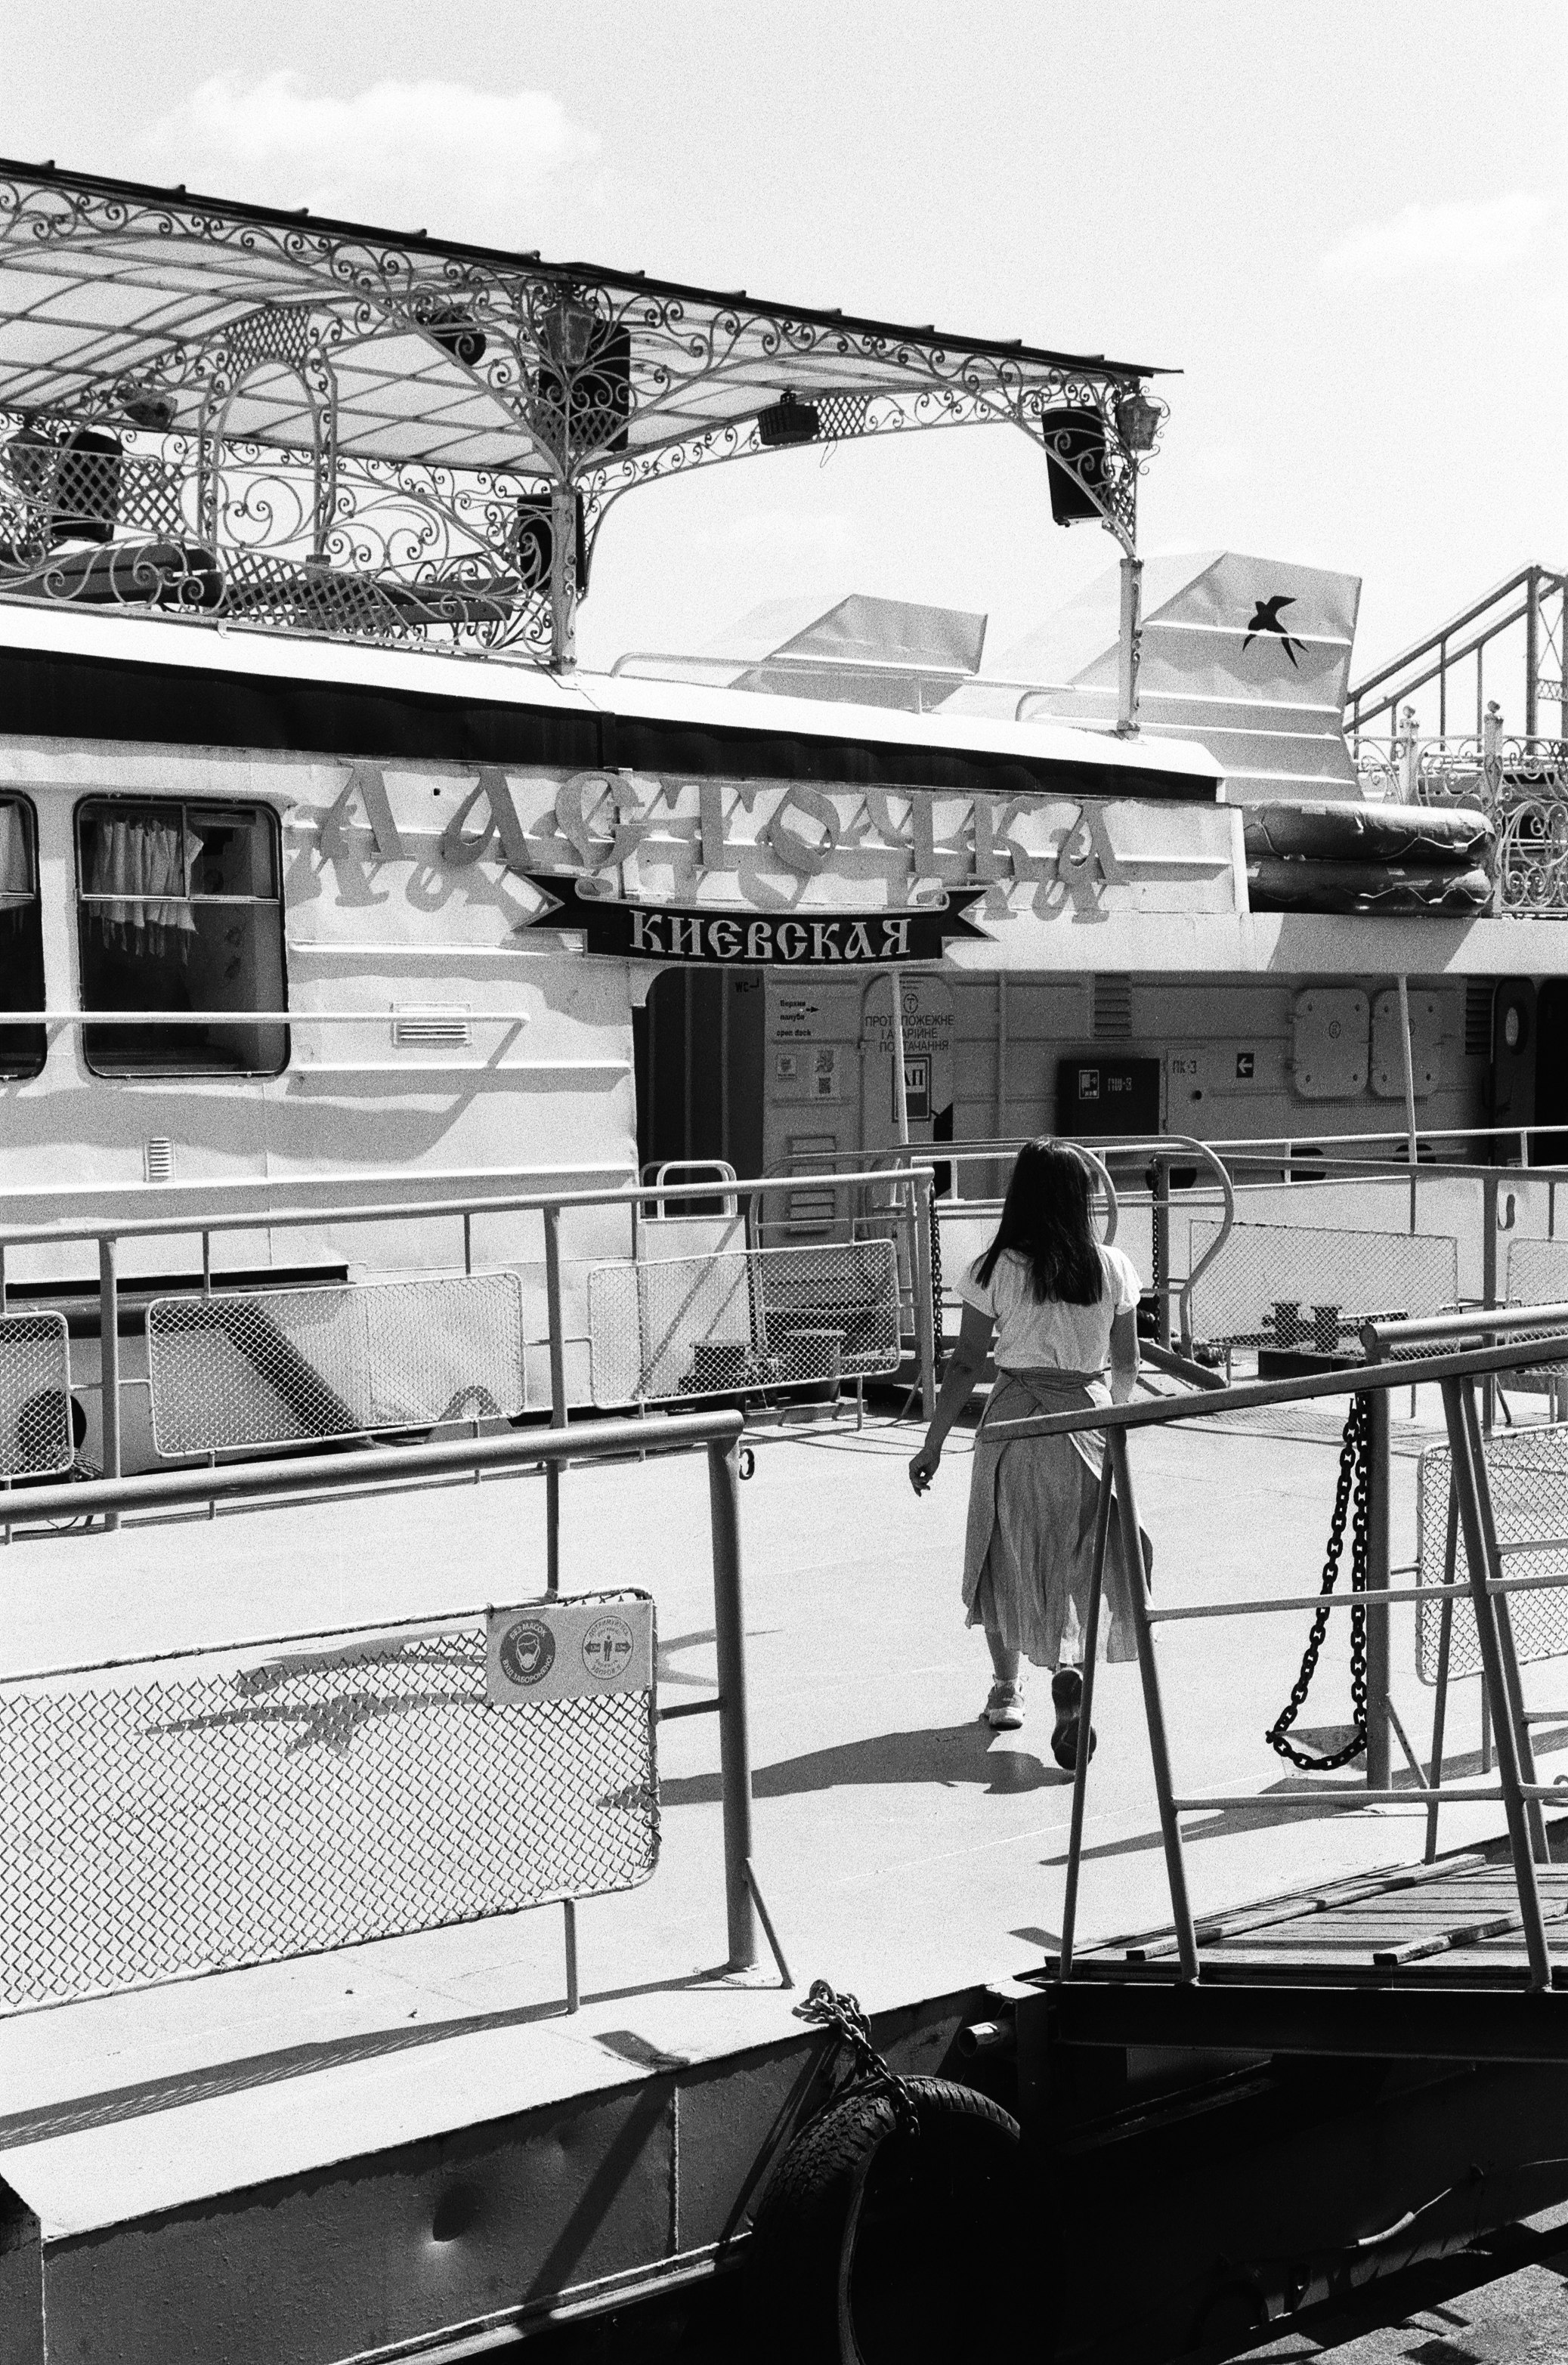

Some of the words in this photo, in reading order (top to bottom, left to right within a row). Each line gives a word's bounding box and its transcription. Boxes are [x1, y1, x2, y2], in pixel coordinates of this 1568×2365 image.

[320, 758, 1132, 886] ЛАСТОЧКА
[630, 909, 912, 960] КИЕВСКАЯ
[865, 1014, 955, 1027] ПРОТПОЖЕЖНЕ
[886, 1027, 938, 1040] ААРІЙНЕ
[879, 1040, 949, 1053] ПОТАЧАННЯ
[509, 1625, 522, 1640] БЕЗ
[522, 1621, 547, 1637] МАСОК
[503, 1659, 514, 1677] ВХІД
